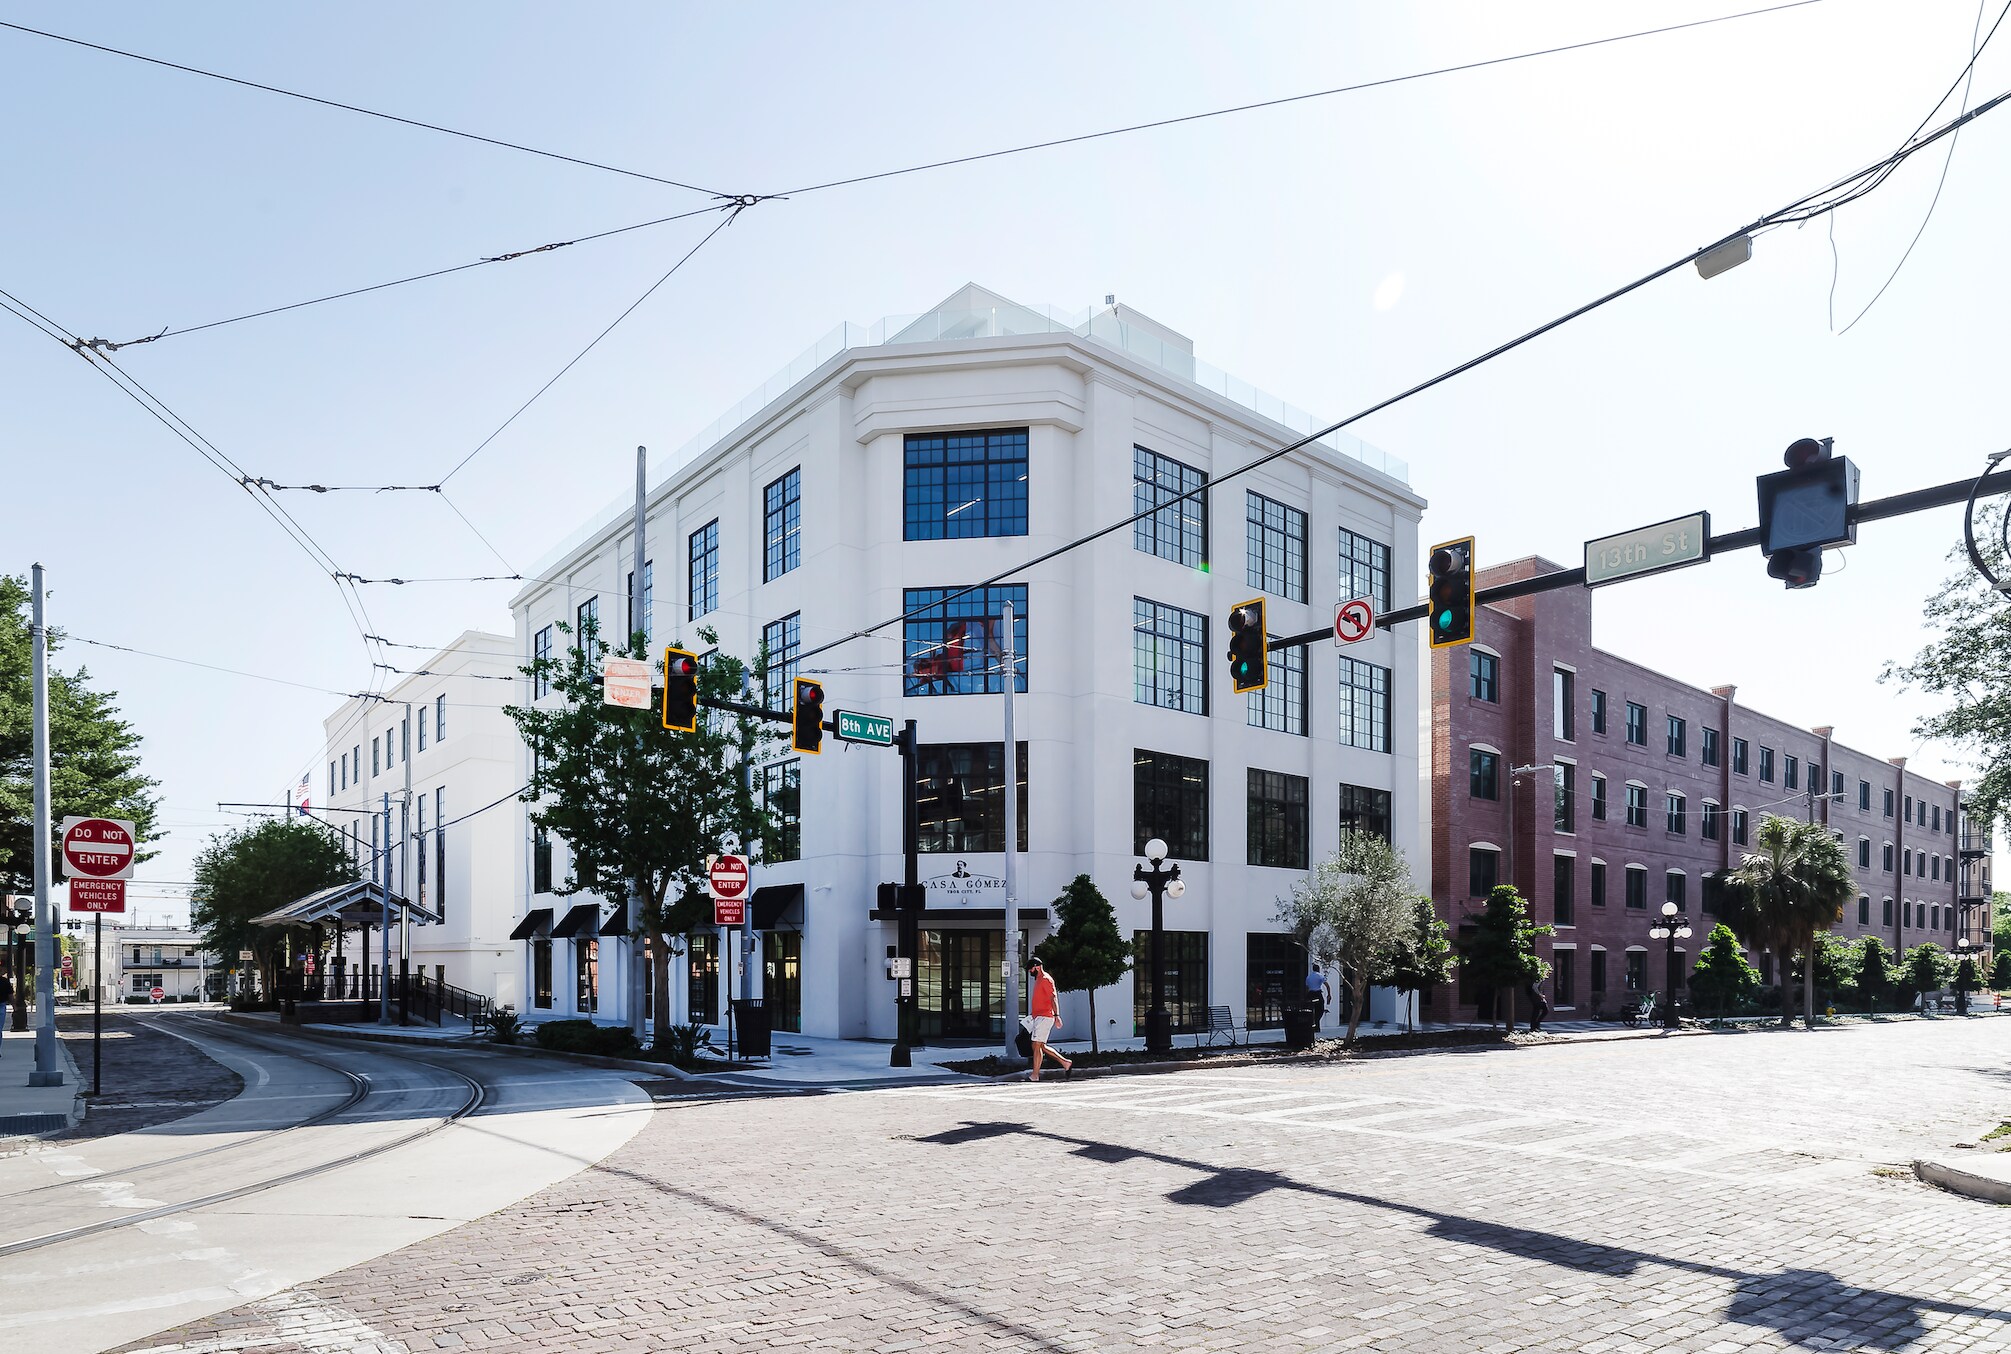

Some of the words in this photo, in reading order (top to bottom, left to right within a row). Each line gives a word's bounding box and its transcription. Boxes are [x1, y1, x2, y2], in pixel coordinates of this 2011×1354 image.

[1600, 542, 1647, 570] 13th
[1662, 531, 1688, 555] St
[841, 717, 861, 733] 8th
[866, 722, 890, 738] AVE
[75, 828, 92, 838] DO
[102, 830, 124, 840] NOT
[79, 854, 119, 865] ENTER
[715, 862, 725, 870] DO
[730, 862, 742, 870] NOT
[73, 881, 122, 890] EMERGENCY
[718, 881, 740, 889] ENTER
[966, 877, 1007, 888] GÓMEZ
[78, 891, 117, 900] VEHICLES
[86, 901, 109, 910] ONLY
